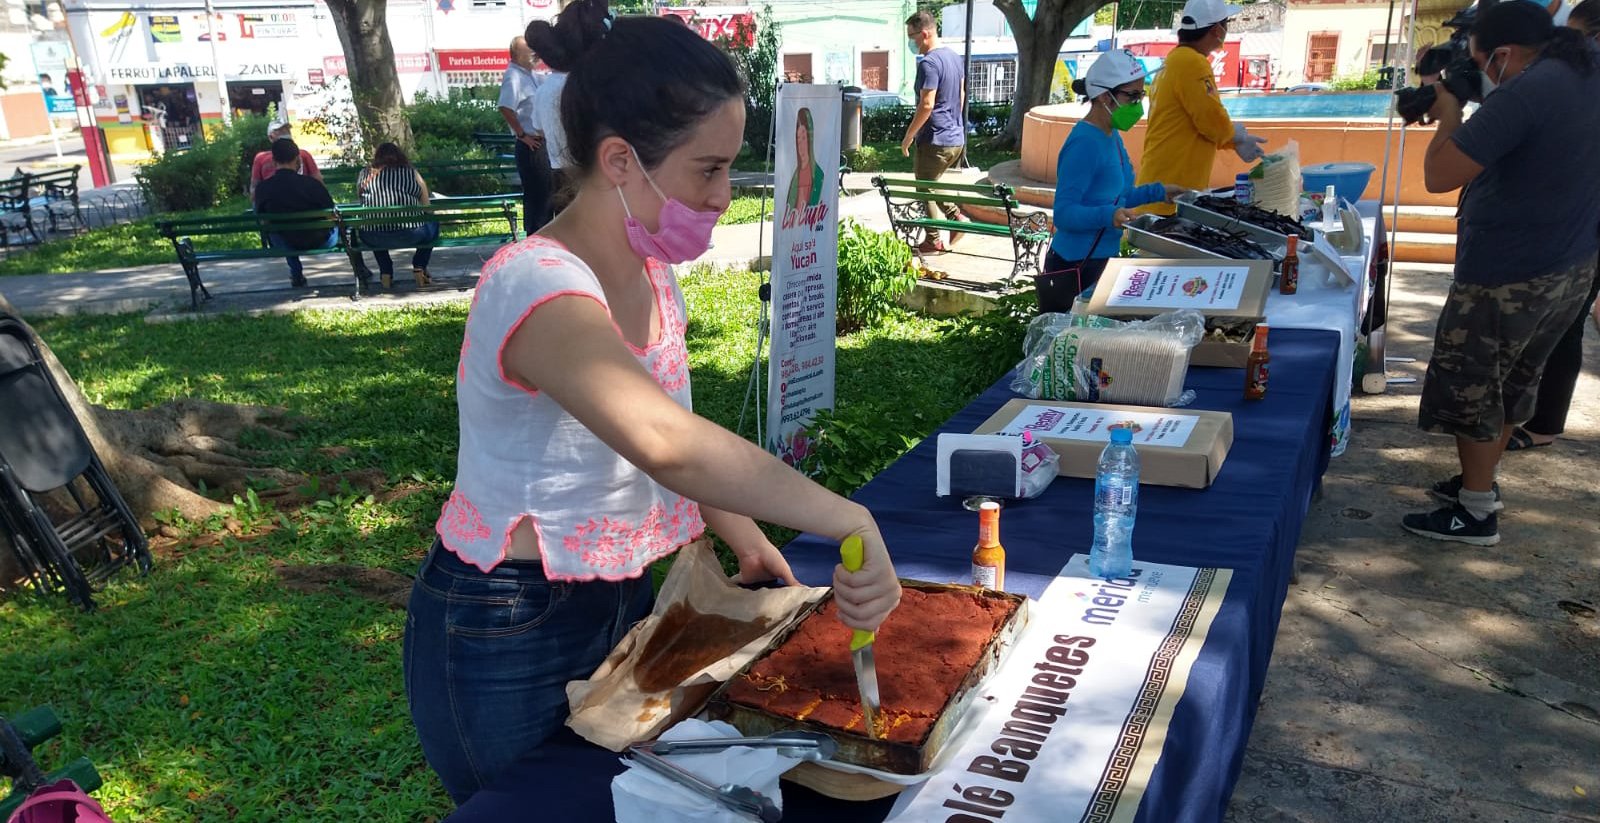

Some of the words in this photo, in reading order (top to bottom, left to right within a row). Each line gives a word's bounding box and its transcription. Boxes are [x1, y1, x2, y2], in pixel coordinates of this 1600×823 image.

[110, 64, 217, 80] FERROTLAPALERI
[238, 63, 288, 76] ZAINE
[448, 56, 472, 66] Partes
[473, 56, 508, 66] Electricas
[1122, 269, 1150, 297] Reality
[1024, 408, 1066, 431] Reality
[966, 634, 1097, 783] Banquetes
